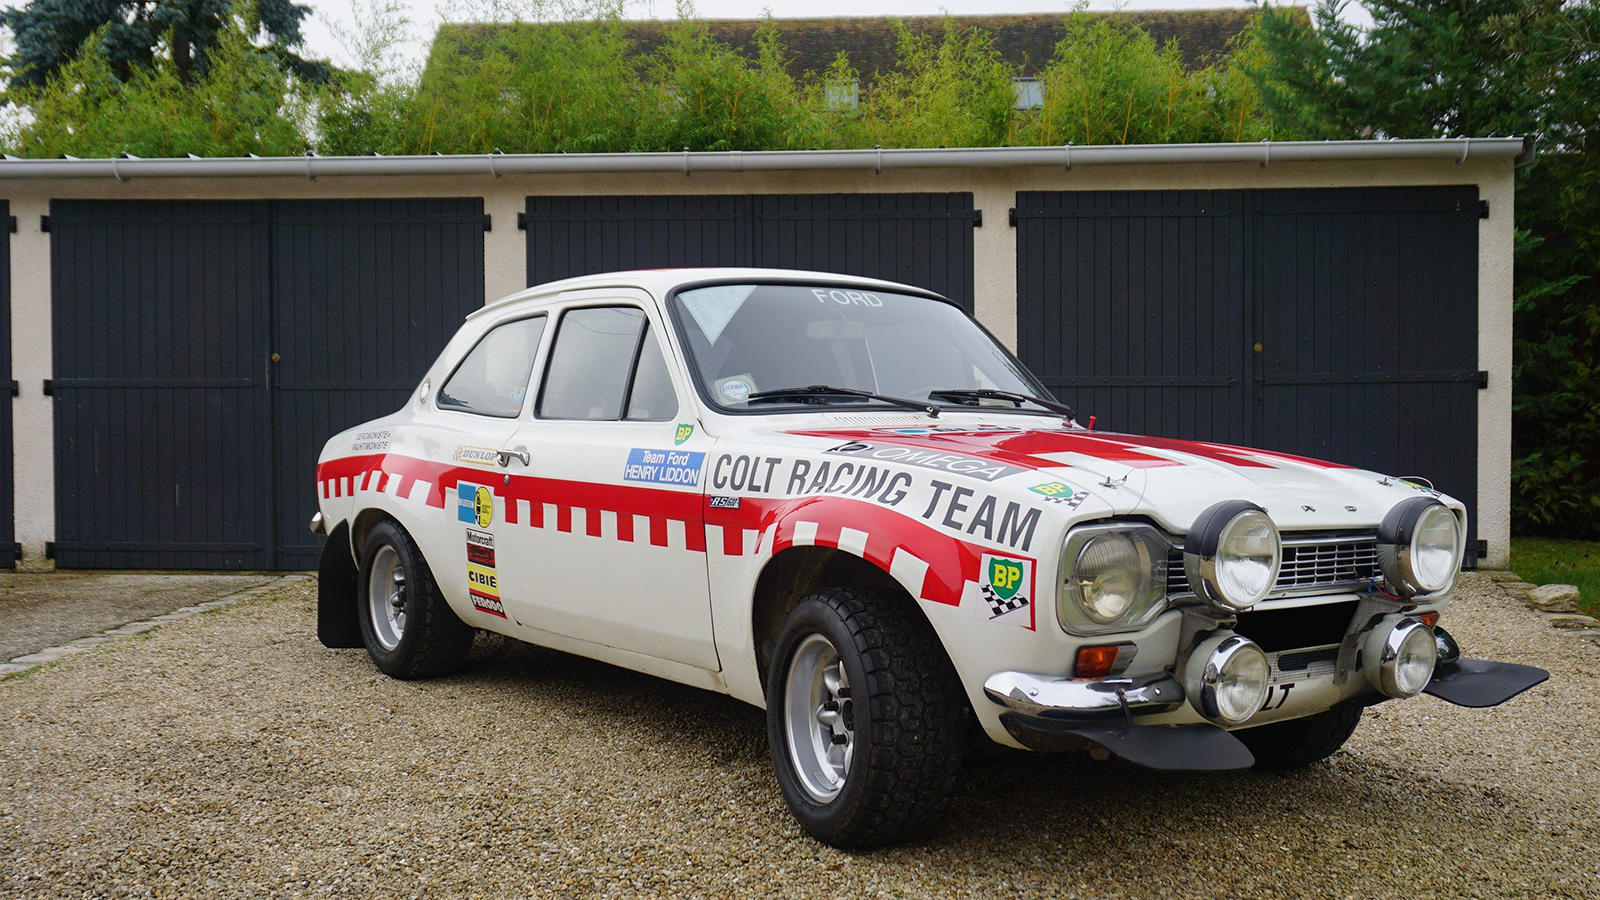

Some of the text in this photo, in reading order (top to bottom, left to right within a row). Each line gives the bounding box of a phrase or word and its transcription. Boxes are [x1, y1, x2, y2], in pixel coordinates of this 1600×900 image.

[811, 289, 883, 308] FORD
[676, 427, 691, 441] BP
[462, 449, 497, 461] DUNLOP
[643, 451, 689, 466] Team Ford
[871, 447, 1007, 479] OMEGA
[624, 464, 699, 484] HENRY LIDDON
[1040, 481, 1067, 496] BP
[713, 453, 1042, 552] COLT RACING TEAM
[467, 531, 493, 546] Motorcraft
[992, 565, 1021, 590] BP
[471, 594, 504, 613] FERODO
